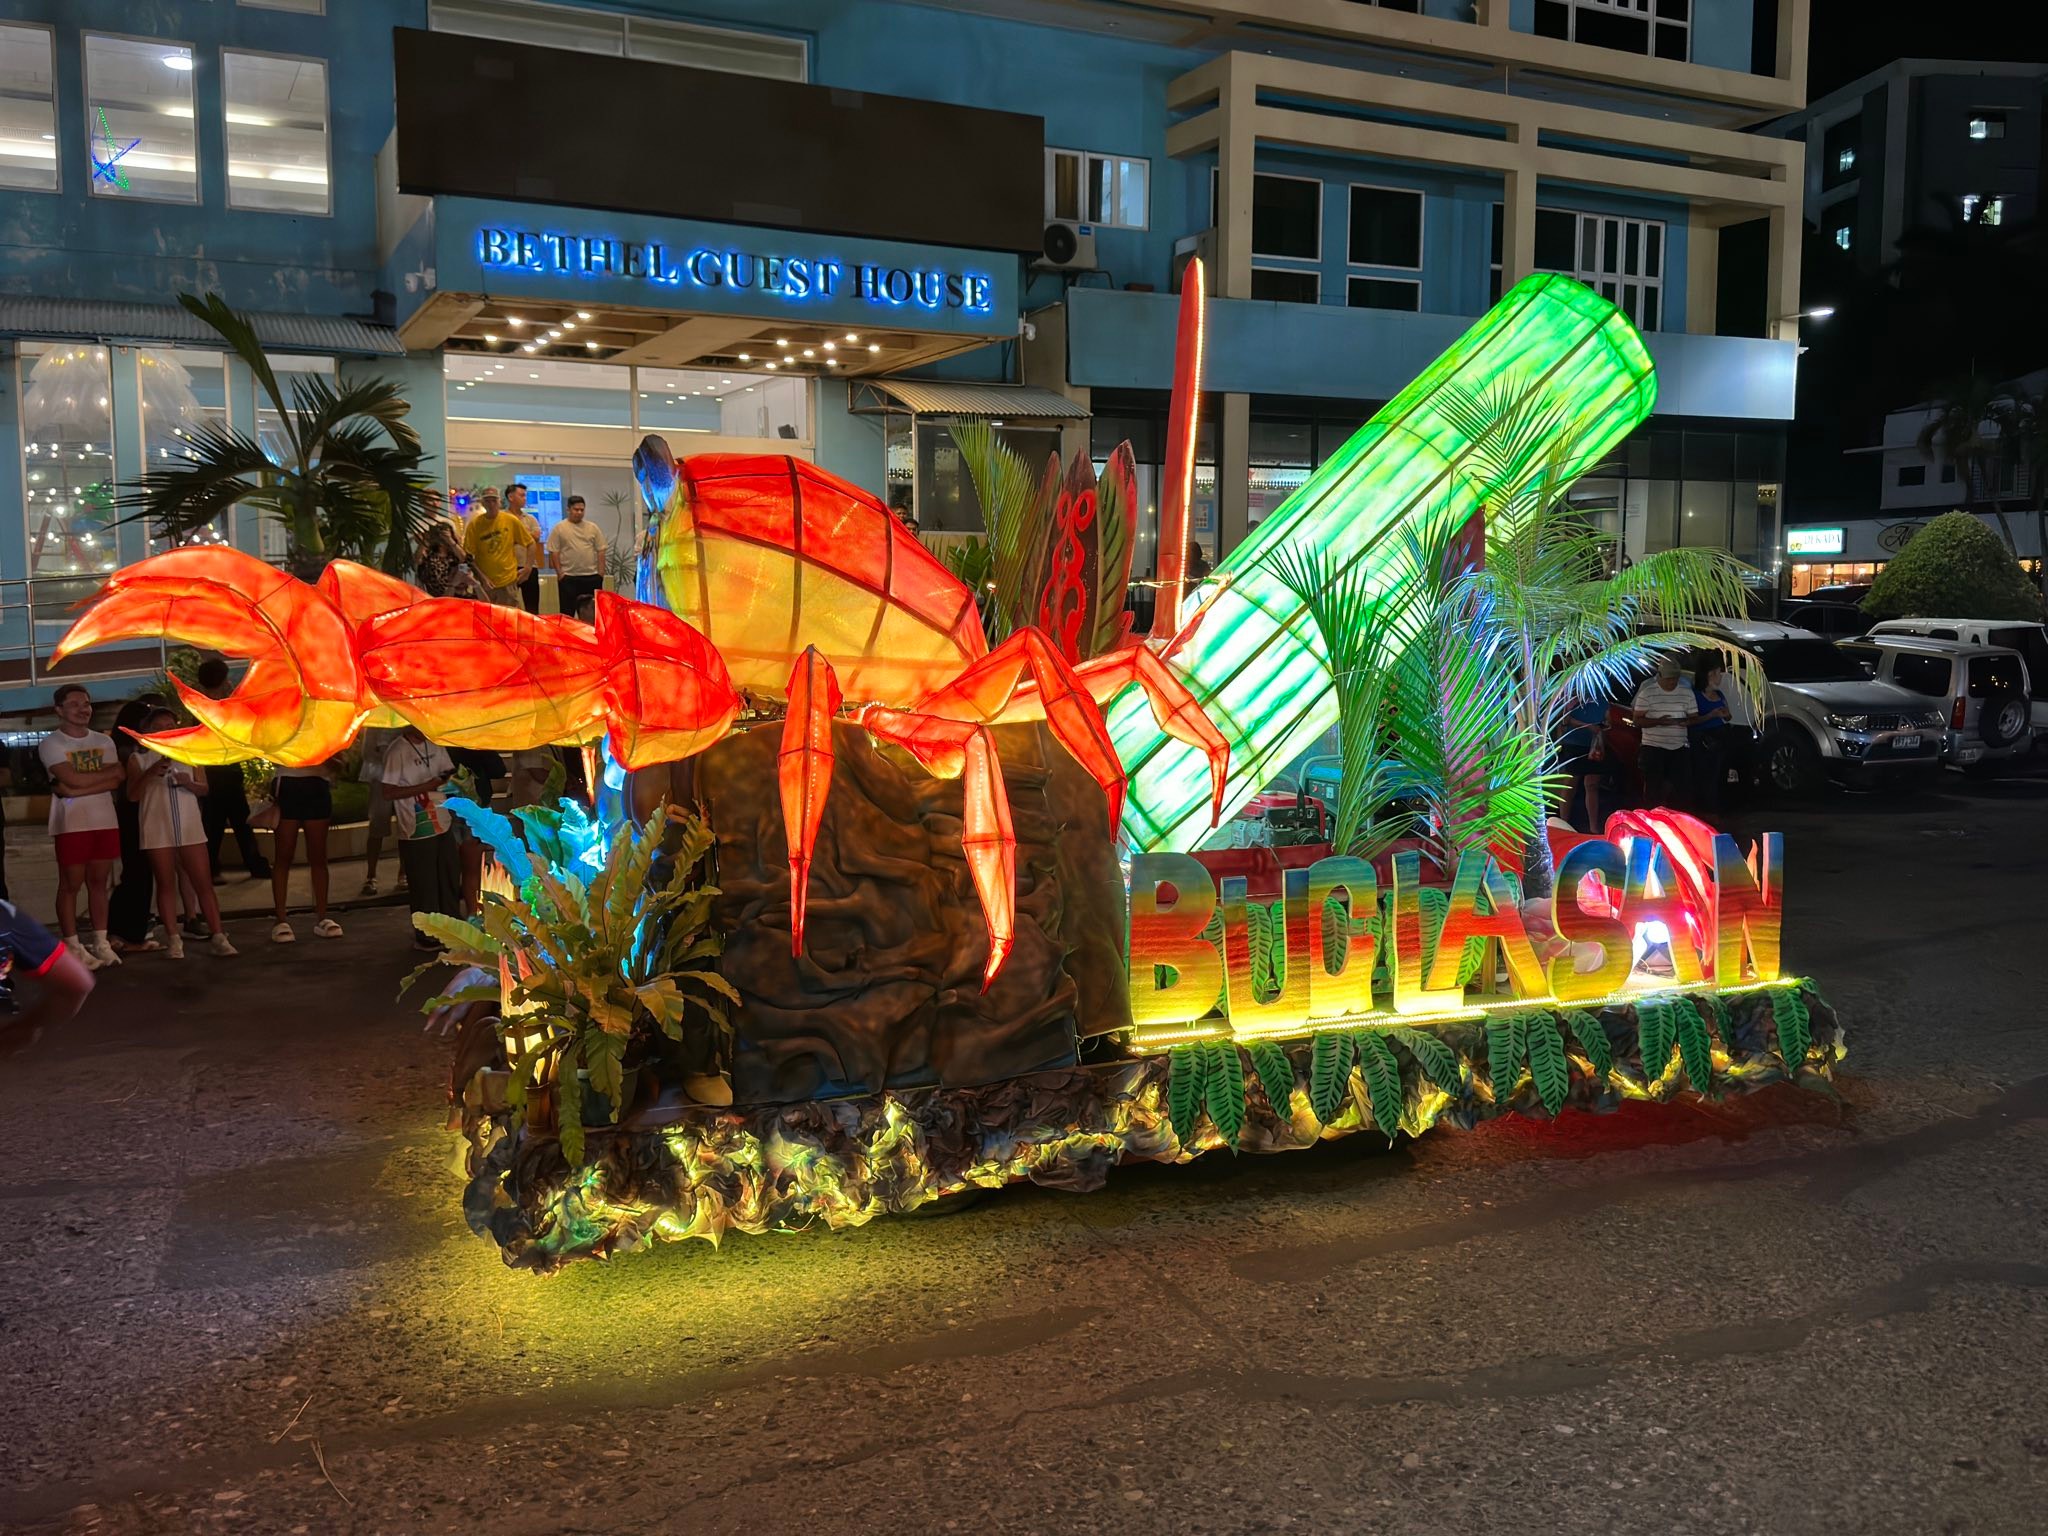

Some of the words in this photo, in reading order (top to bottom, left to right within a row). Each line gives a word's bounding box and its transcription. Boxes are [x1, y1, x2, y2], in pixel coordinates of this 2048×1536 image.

[481, 228, 677, 283] BETHEL
[689, 249, 839, 297] GUEST
[852, 265, 990, 309] HOUSE
[1130, 832, 1784, 1032] BUGLASAN
